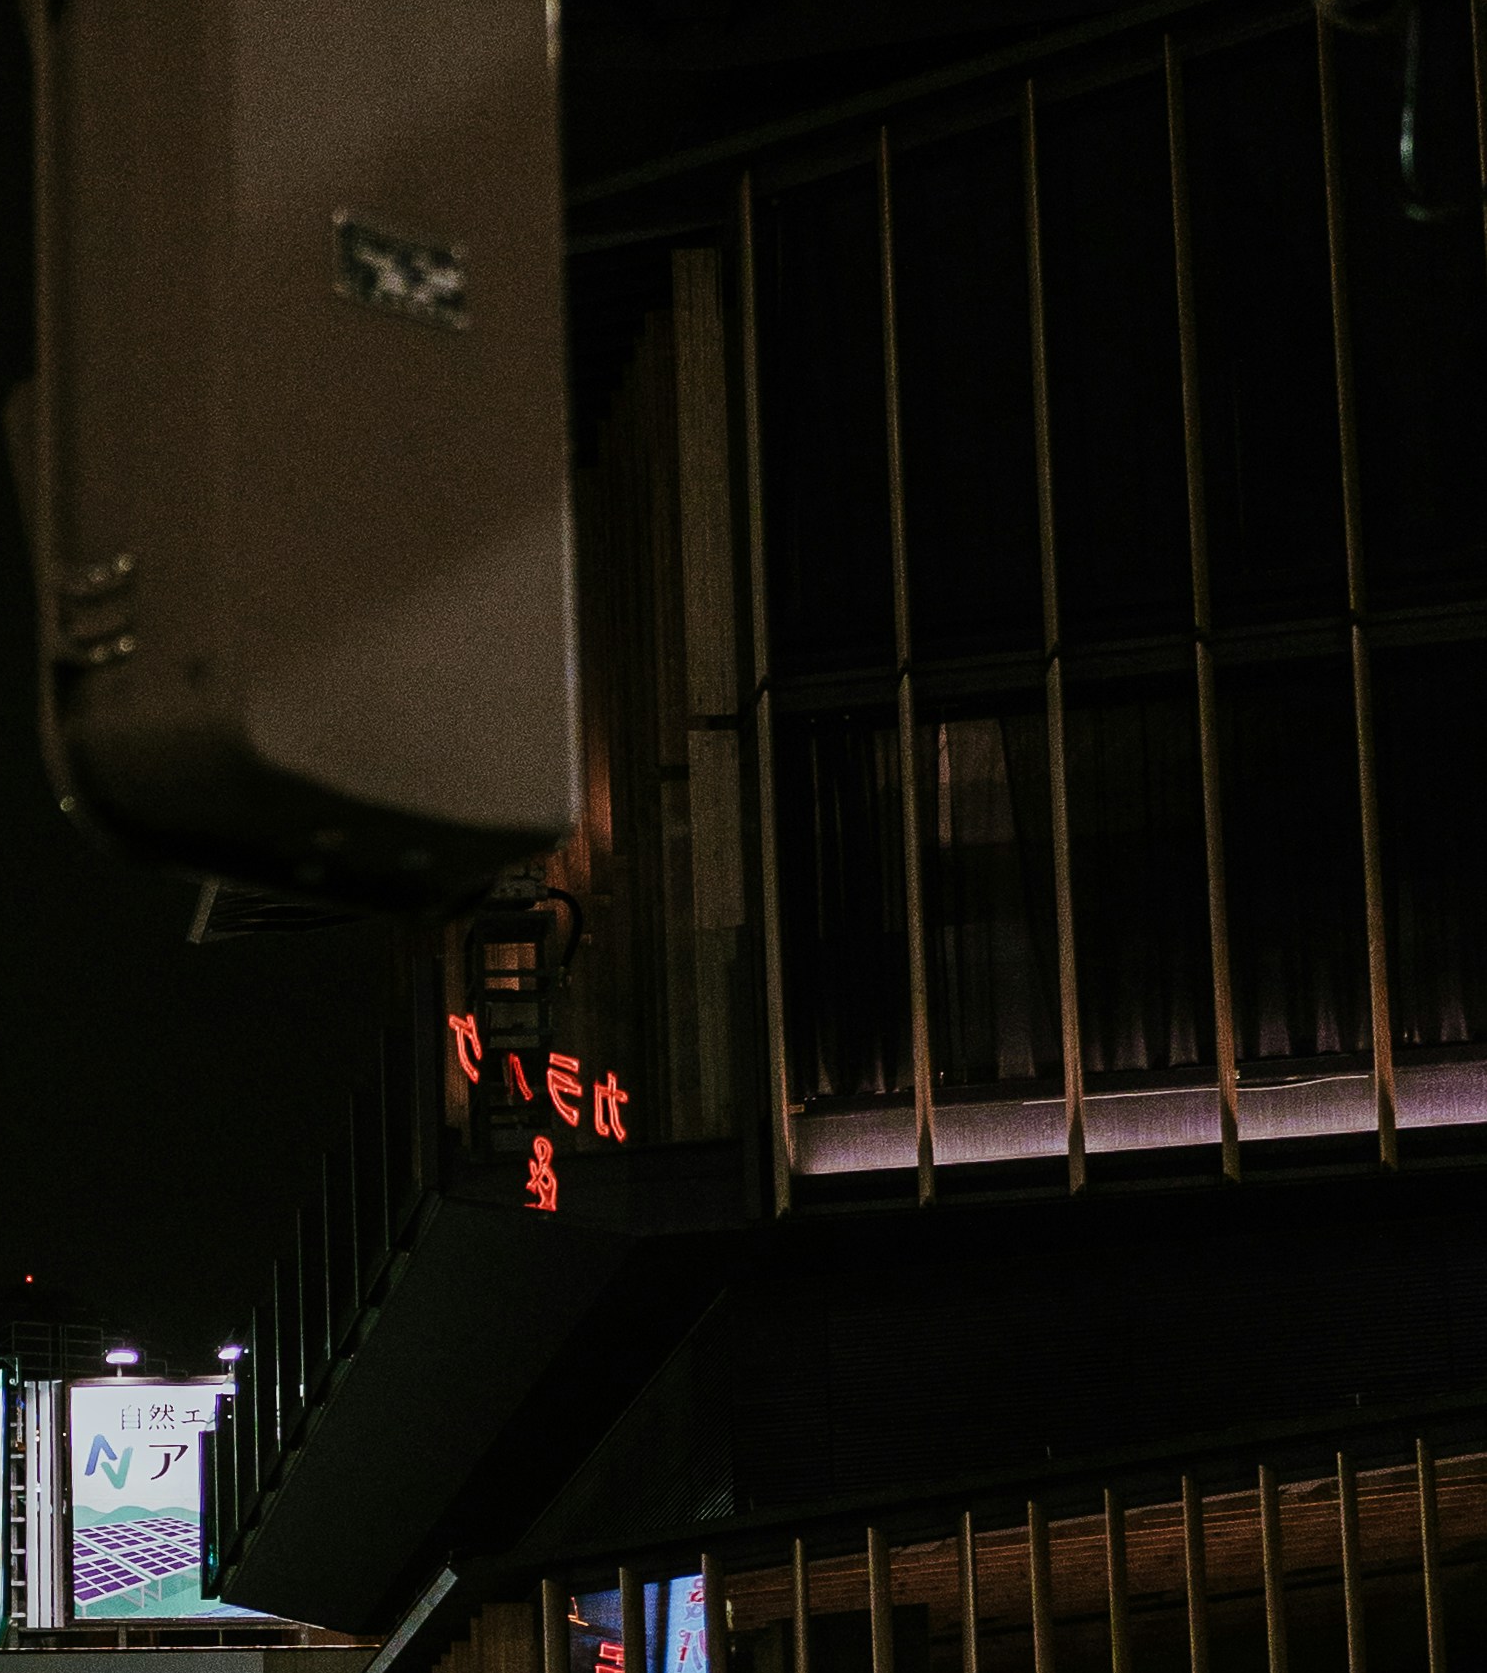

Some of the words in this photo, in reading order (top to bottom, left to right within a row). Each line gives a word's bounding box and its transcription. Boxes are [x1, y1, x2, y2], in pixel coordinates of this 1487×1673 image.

[121, 1403, 215, 1431] 自然エ
[149, 1444, 189, 1480] ア
